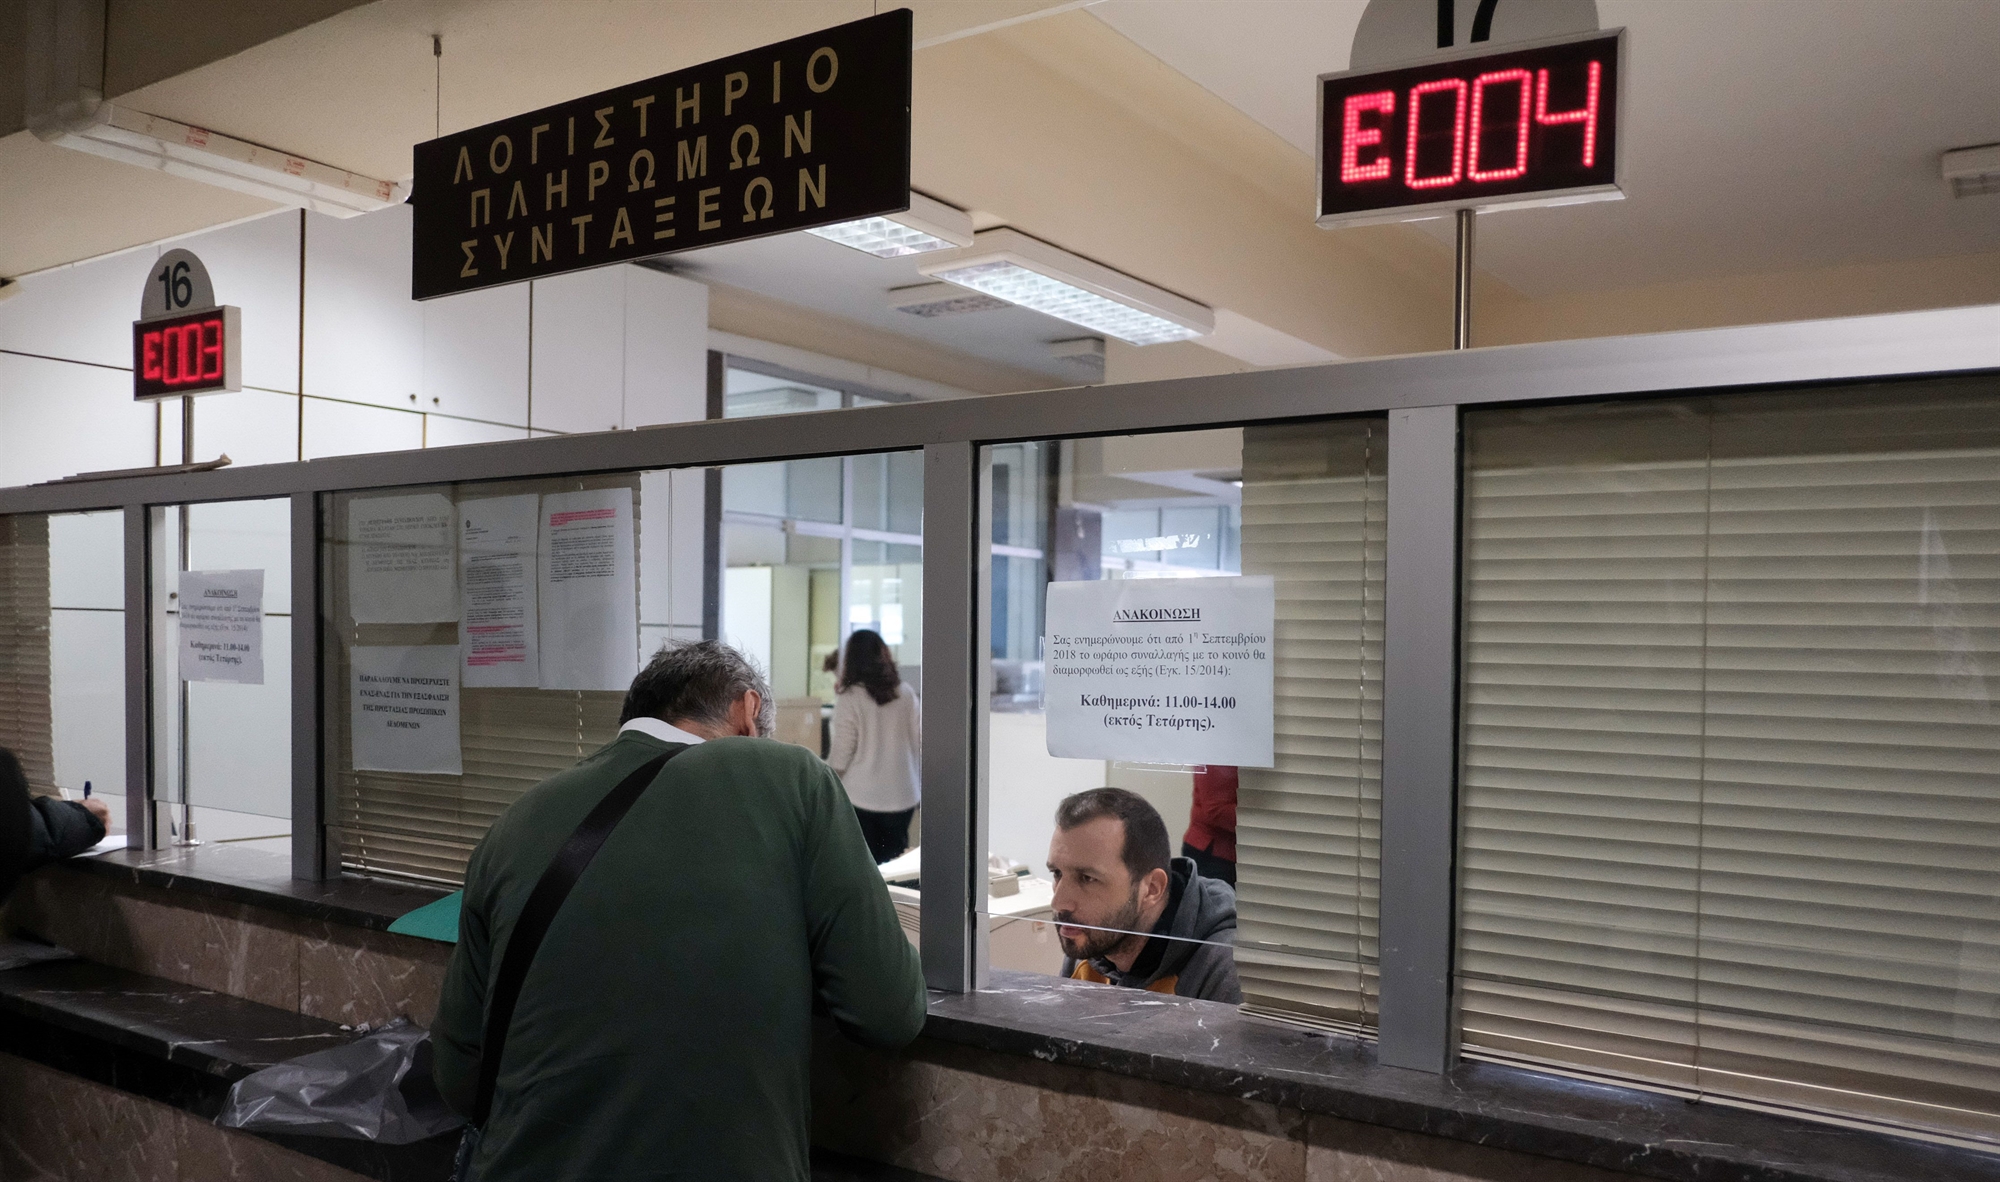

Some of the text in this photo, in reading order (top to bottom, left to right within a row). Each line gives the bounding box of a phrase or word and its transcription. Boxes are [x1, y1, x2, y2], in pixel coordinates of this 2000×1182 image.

[454, 46, 839, 185] ΛΟΓΙΣΤΗΡΙΟ
[470, 110, 813, 229] ΠΛΗΡΩΜΩΝ
[460, 164, 827, 279] ΣΥΝΤΑΞΕΩΝ
[158, 261, 193, 311] 16
[1113, 608, 1201, 622] ΑΝΑΚΟΙΝΩΣΗ
[1053, 634, 1071, 647] Σας
[1074, 634, 1144, 647] ενημερώνουμε
[1147, 633, 1161, 645] ότι
[1165, 633, 1184, 644] από
[1202, 632, 1266, 646] Σεπτεμβρίου
[1053, 648, 1266, 662] 2018 το ωράριο συναλλαγής με το κοινό θα
[1052, 664, 1231, 678] διαμορφωθεί ως εξής (Εγκ. 15/2014):
[1080, 694, 1236, 710] Καθημερινά: 11.00-14.00
[1103, 713, 1215, 731] (εκτός Τετάρτης).
